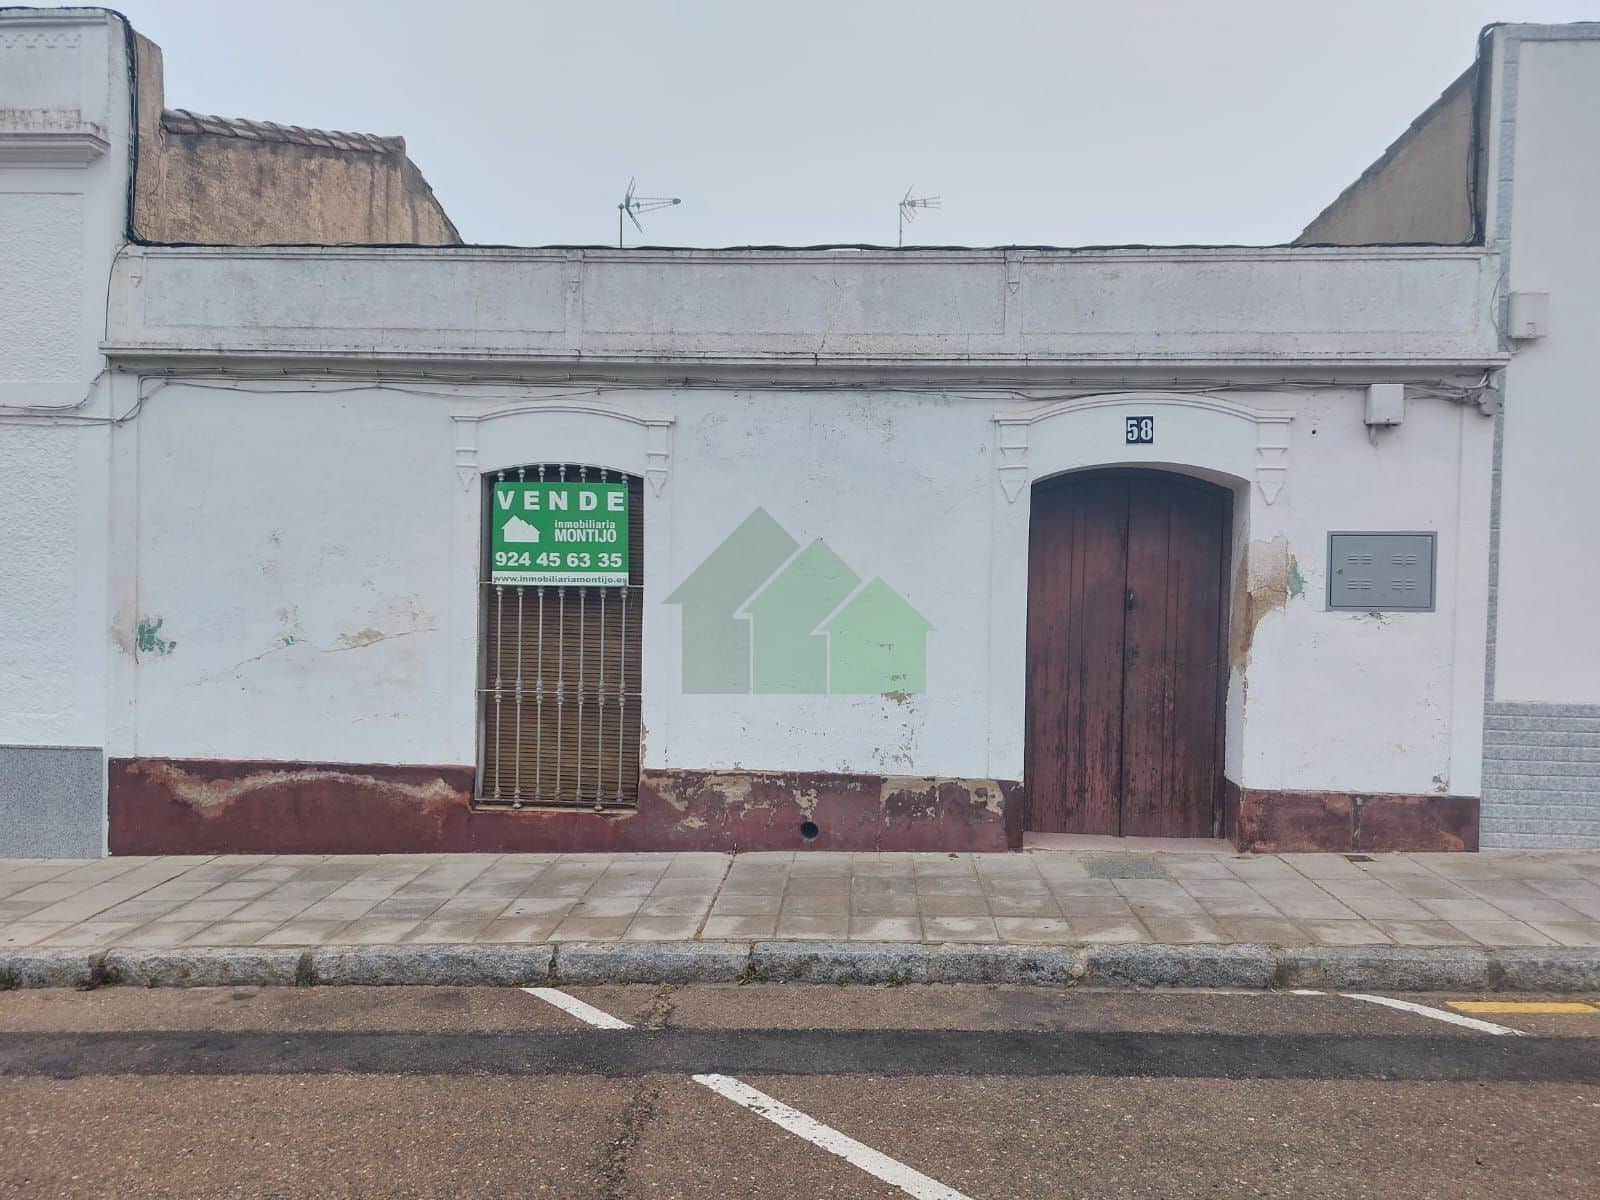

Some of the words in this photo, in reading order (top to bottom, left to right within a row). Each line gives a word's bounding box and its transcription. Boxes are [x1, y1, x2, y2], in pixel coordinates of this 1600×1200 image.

[1127, 419, 1153, 441] 58
[497, 490, 625, 511] VENDE
[554, 519, 616, 529] inmobiliaria
[554, 529, 617, 543] MONTIJO
[495, 551, 531, 567] 924
[536, 552, 561, 567] 45
[566, 552, 591, 567] 63
[597, 552, 622, 568] 35
[493, 574, 628, 586] www.inmobiliariamontijo.es
